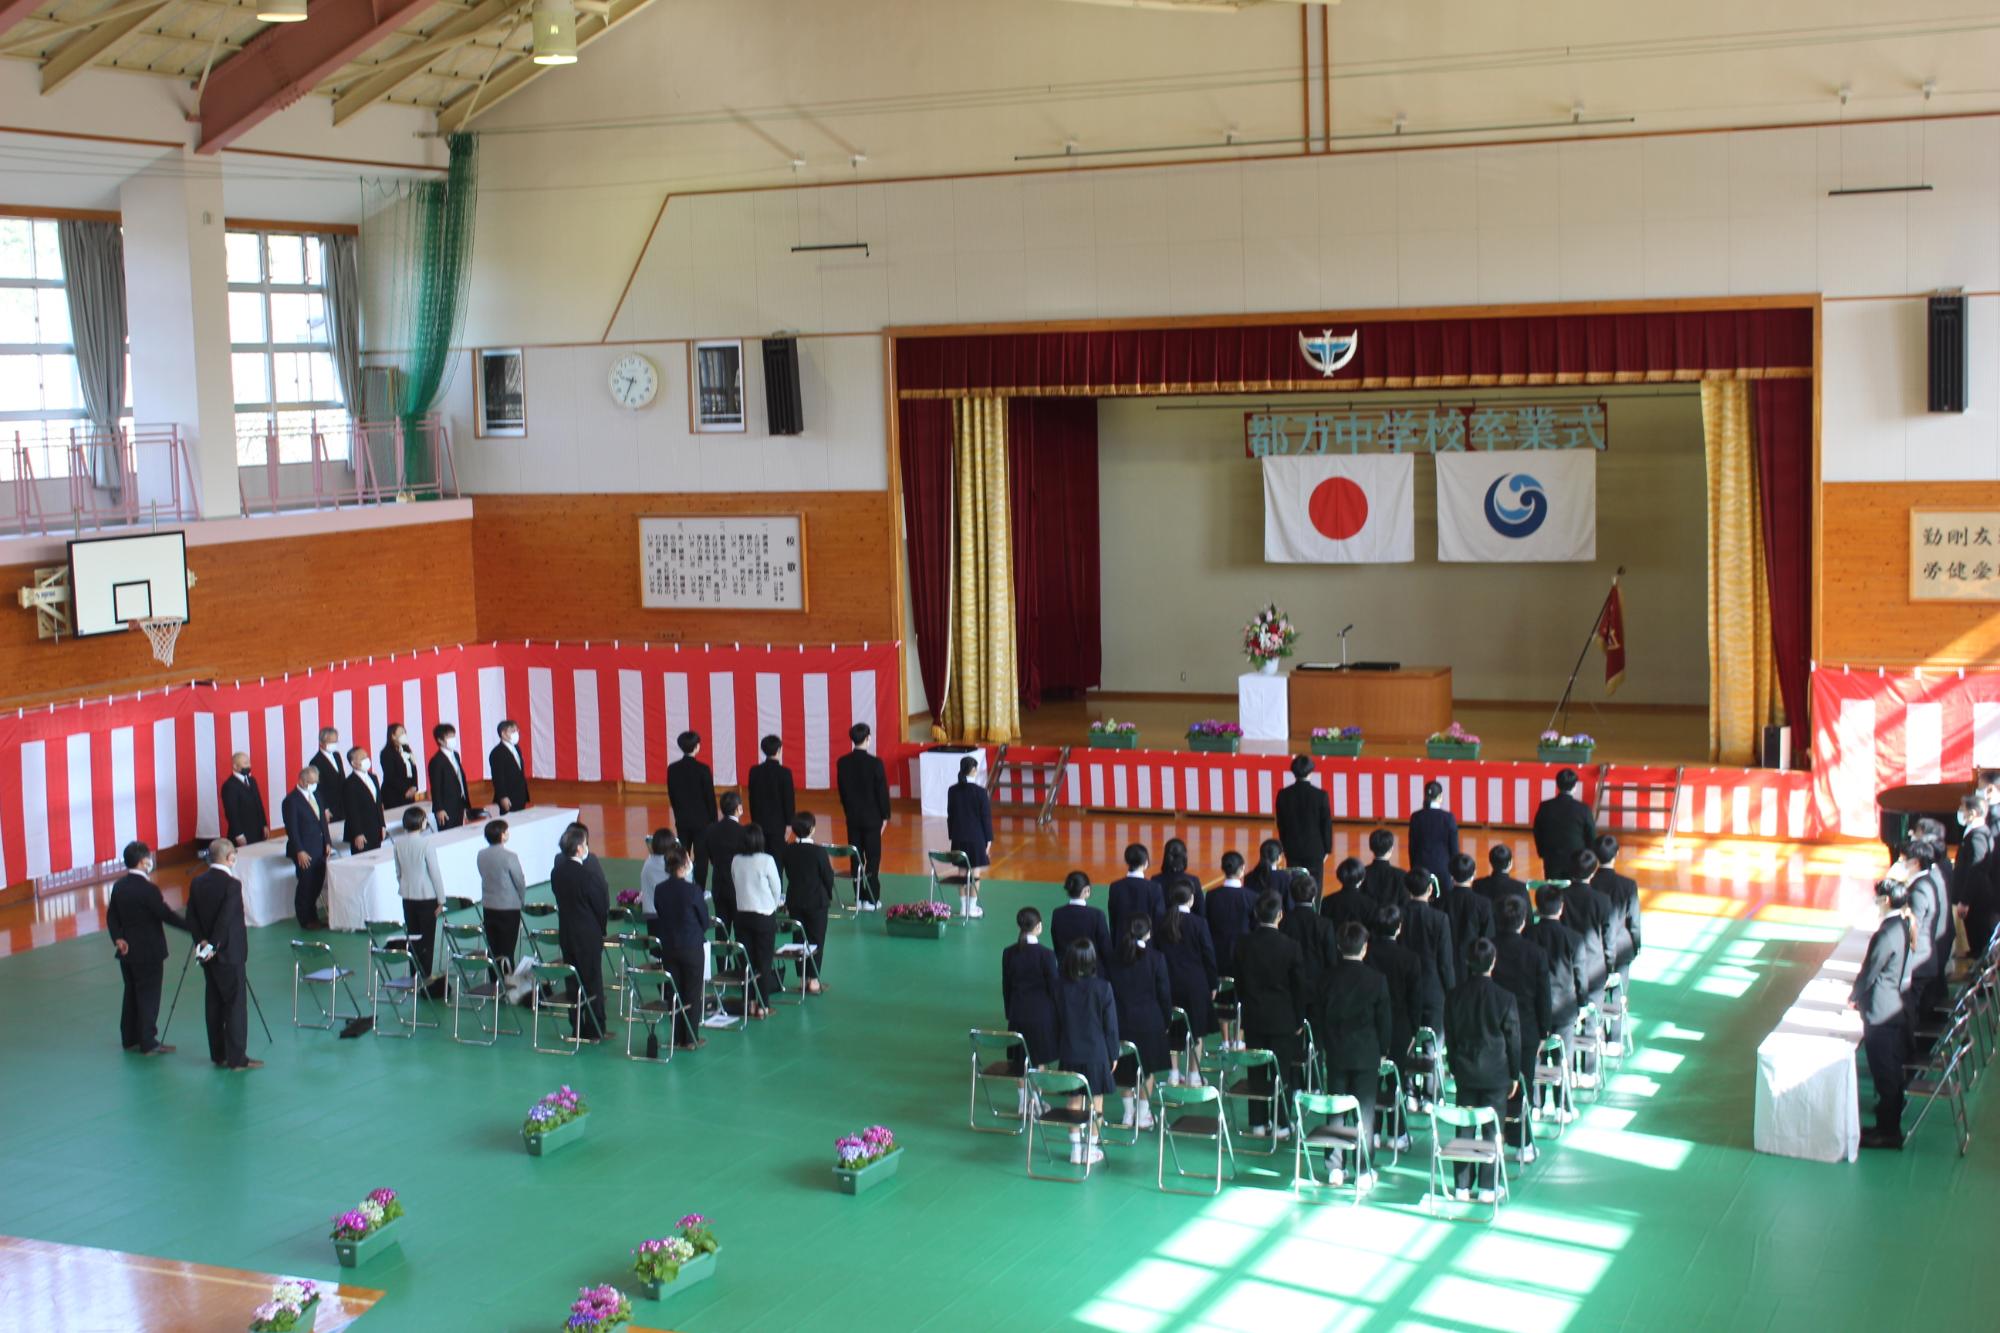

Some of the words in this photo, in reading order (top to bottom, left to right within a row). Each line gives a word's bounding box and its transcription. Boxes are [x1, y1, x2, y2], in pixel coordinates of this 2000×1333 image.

[1250, 405, 1605, 457] 都万中学校卒業式
